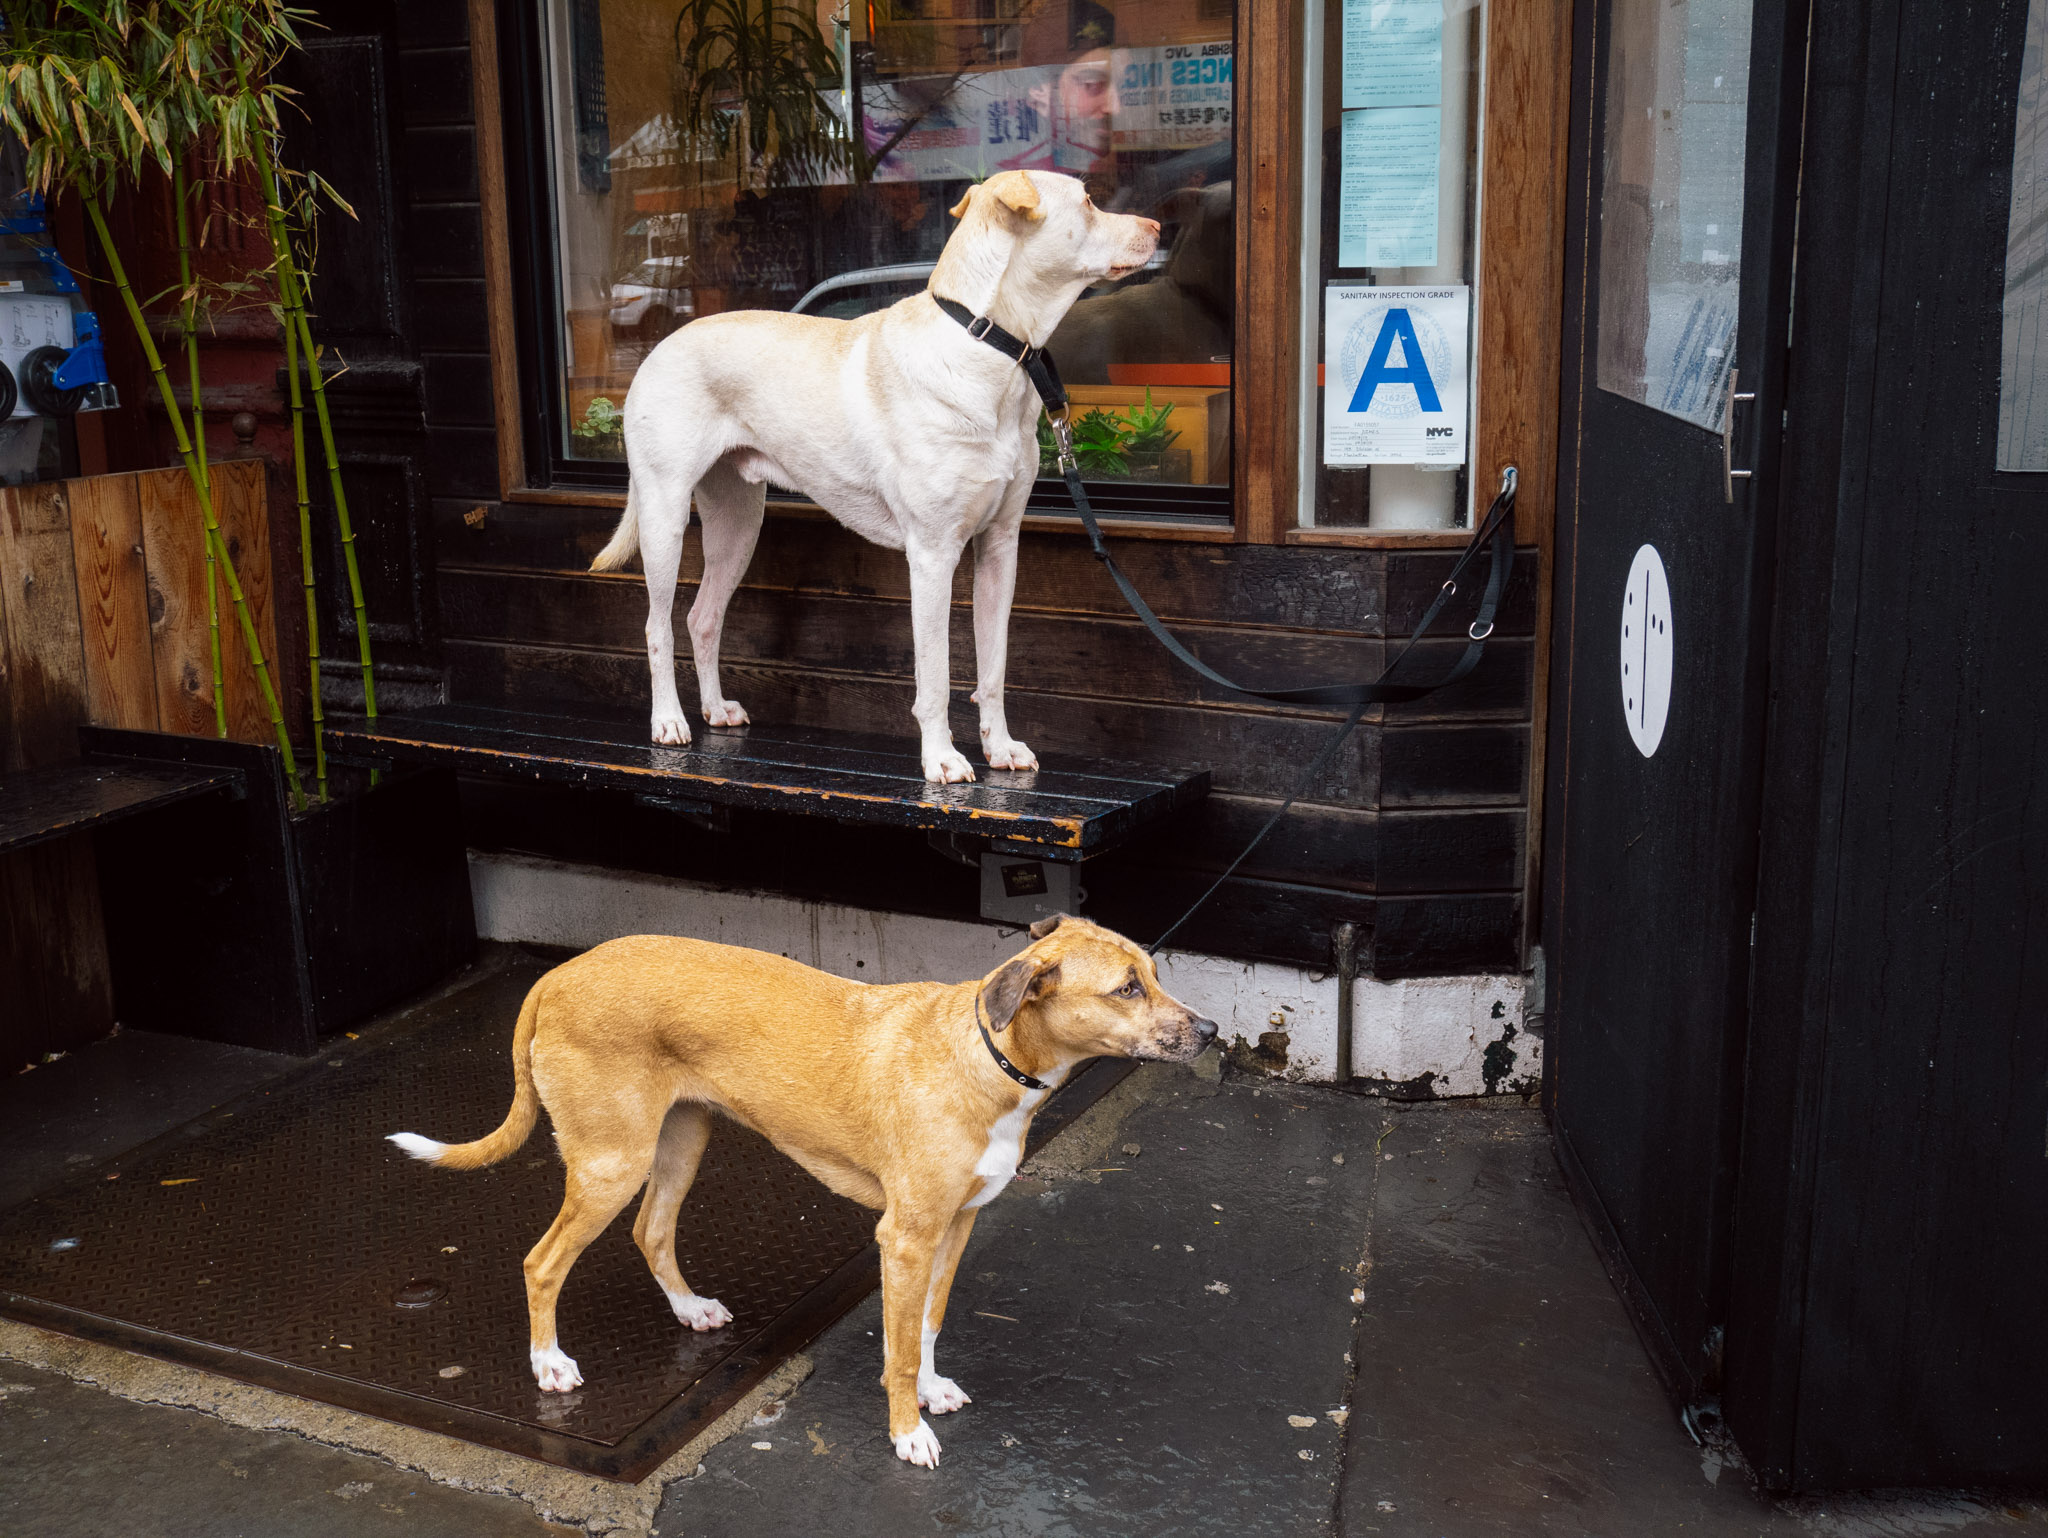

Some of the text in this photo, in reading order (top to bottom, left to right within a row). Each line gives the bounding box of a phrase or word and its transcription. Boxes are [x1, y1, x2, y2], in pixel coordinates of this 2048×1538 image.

[1379, 291, 1425, 299] INSPECTION
[1347, 308, 1443, 412] A
[1426, 427, 1453, 437] NYC
